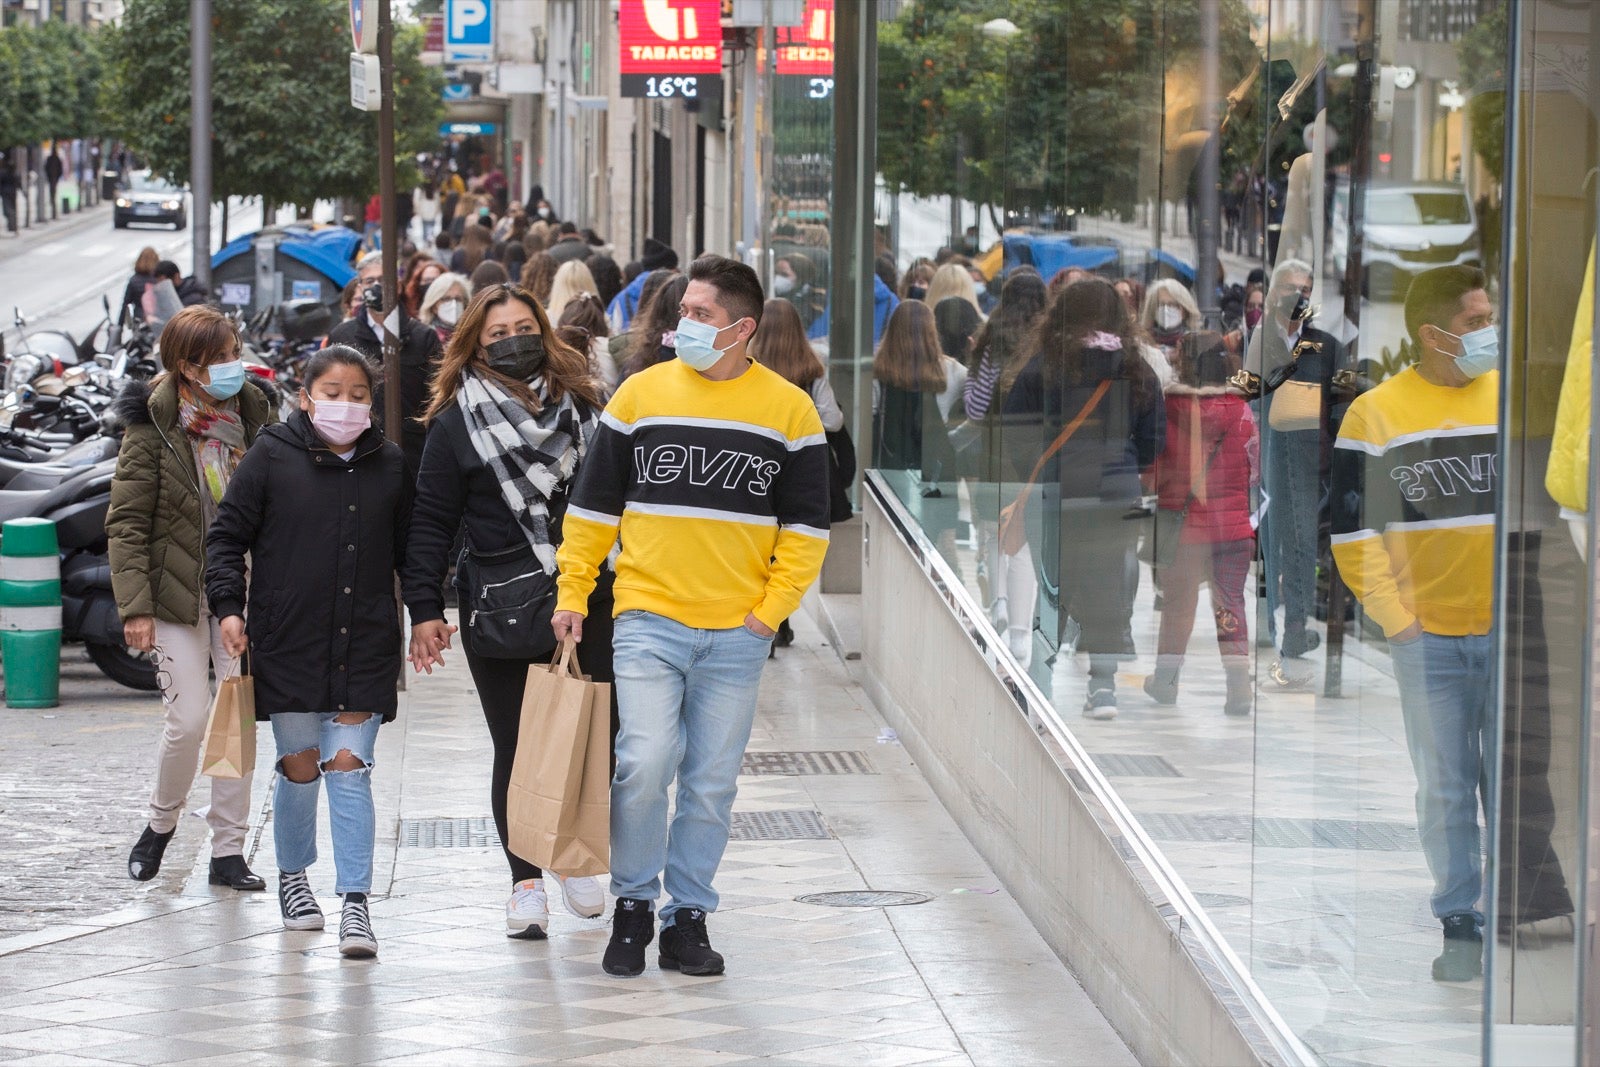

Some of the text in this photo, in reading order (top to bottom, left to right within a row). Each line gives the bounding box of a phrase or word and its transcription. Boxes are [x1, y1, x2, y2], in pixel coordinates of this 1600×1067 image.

[452, 0, 487, 39] P
[630, 46, 716, 60] TABACOS
[646, 77, 697, 97] 16°C
